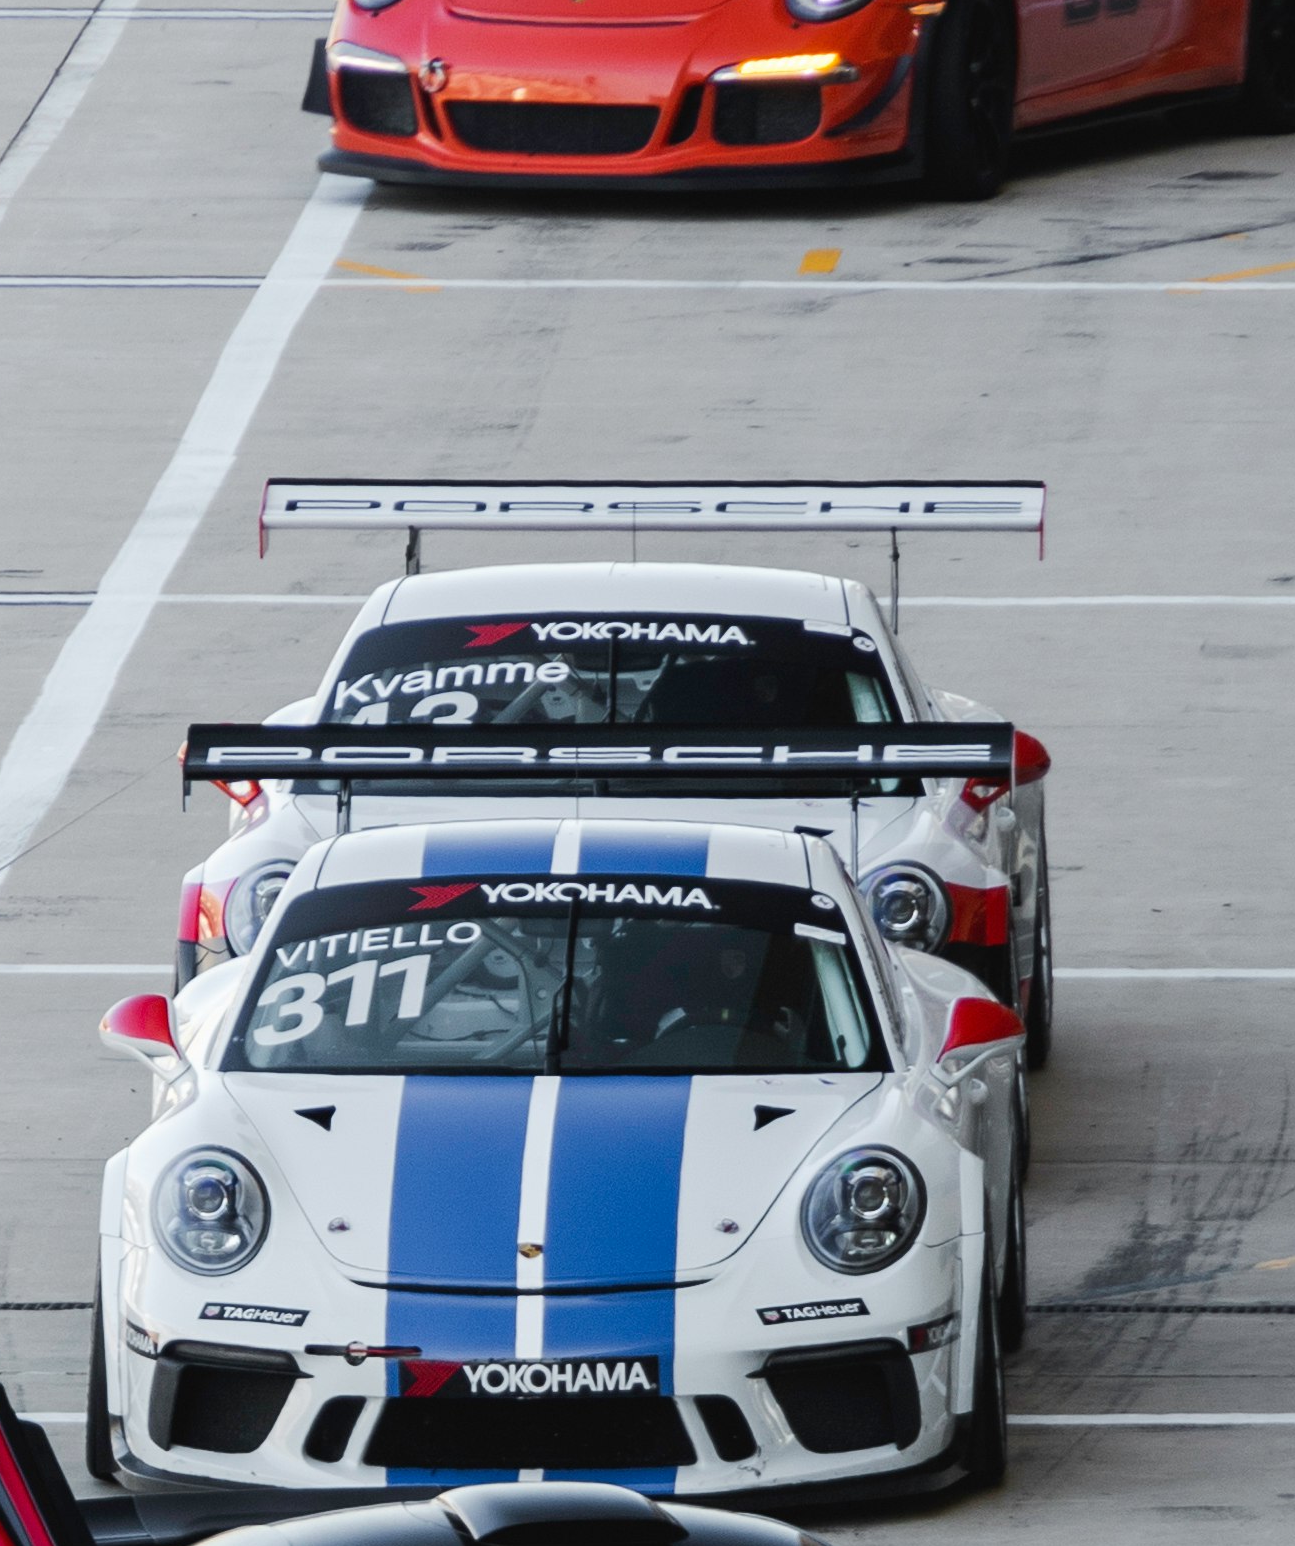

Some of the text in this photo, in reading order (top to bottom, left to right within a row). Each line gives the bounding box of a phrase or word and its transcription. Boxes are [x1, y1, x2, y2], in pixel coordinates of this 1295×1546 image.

[285, 499, 1023, 514] PORSCHE
[530, 622, 752, 645] YOKOHAMA
[333, 660, 570, 710] Kvamme
[206, 744, 992, 764] PORSCHE
[480, 883, 713, 909] YOKOHAMA
[276, 921, 482, 967] VITIELLO
[253, 954, 432, 1047] 311
[462, 1362, 651, 1394] YOKOHAMA
